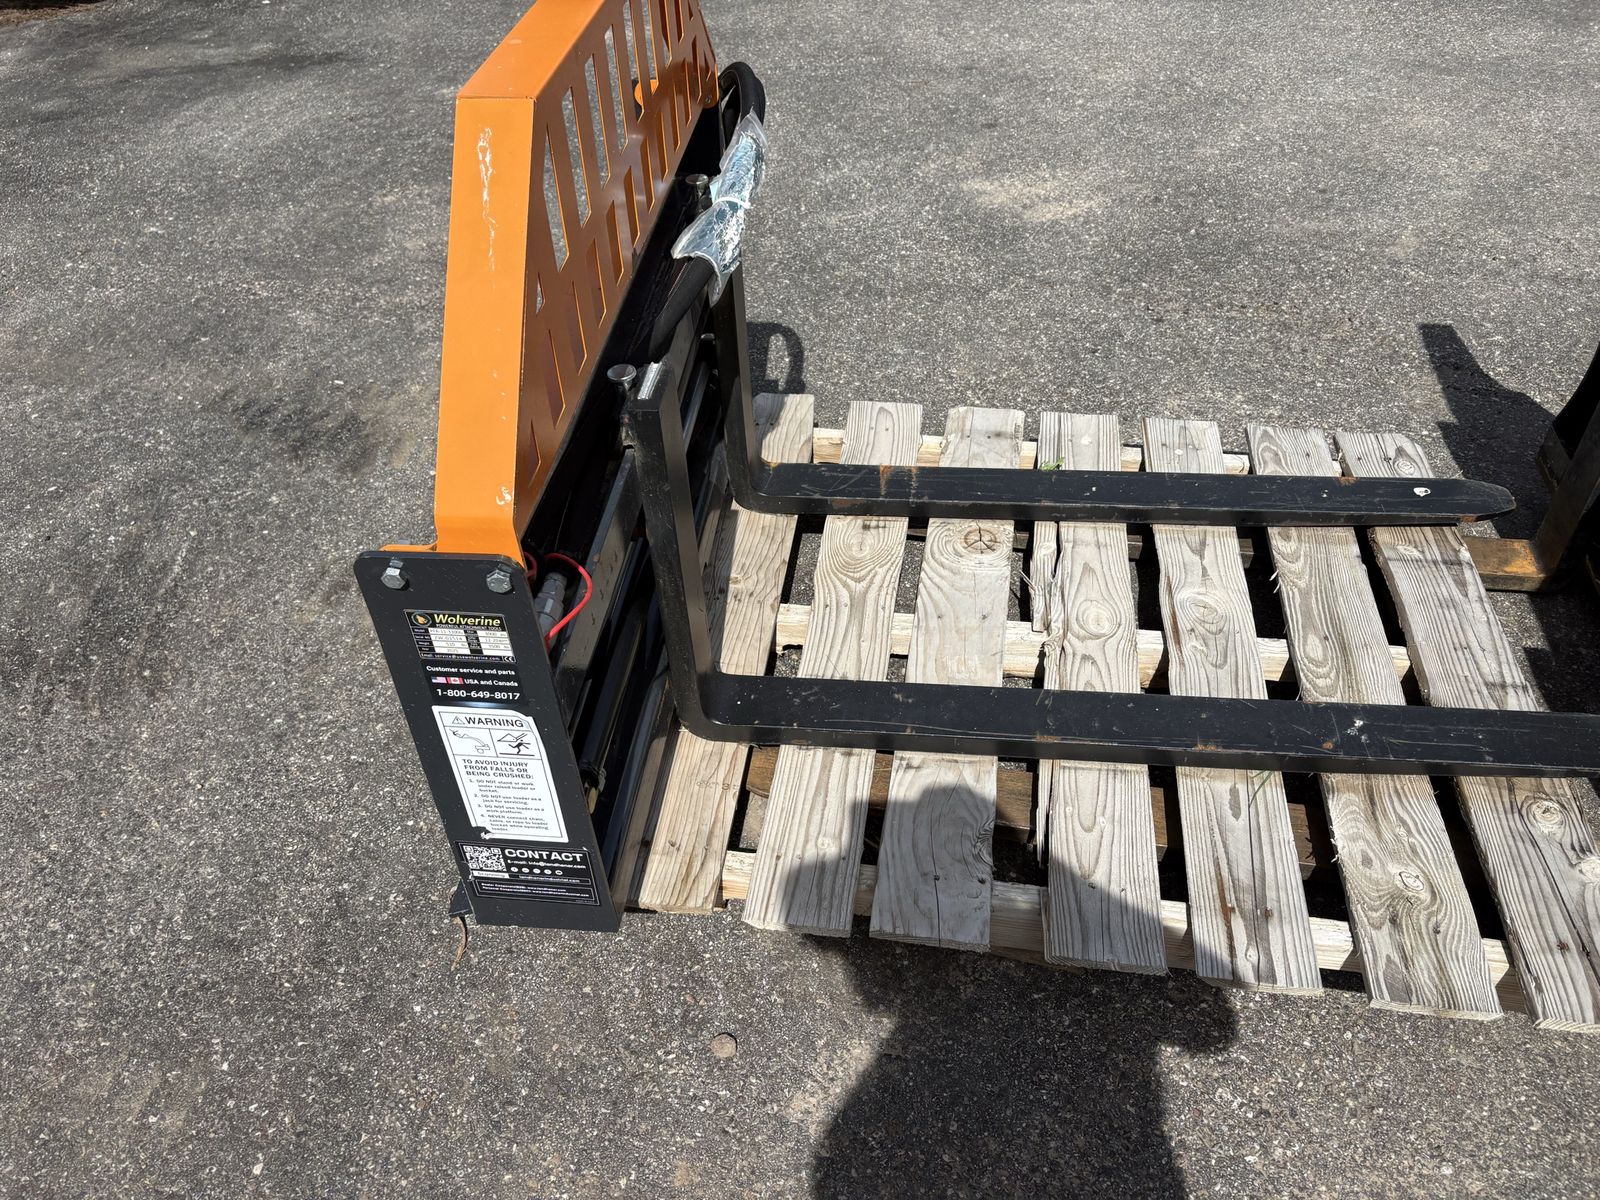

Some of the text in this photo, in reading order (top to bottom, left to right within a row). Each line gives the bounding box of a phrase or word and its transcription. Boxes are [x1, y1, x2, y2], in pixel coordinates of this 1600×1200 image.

[433, 614, 501, 626] Wolverine
[426, 665, 458, 673] Customer
[436, 688, 520, 700] 1-800-649-8017
[465, 716, 524, 728] WARNING
[492, 772, 534, 780] CRUSHED:
[504, 848, 583, 862] CONTACT
